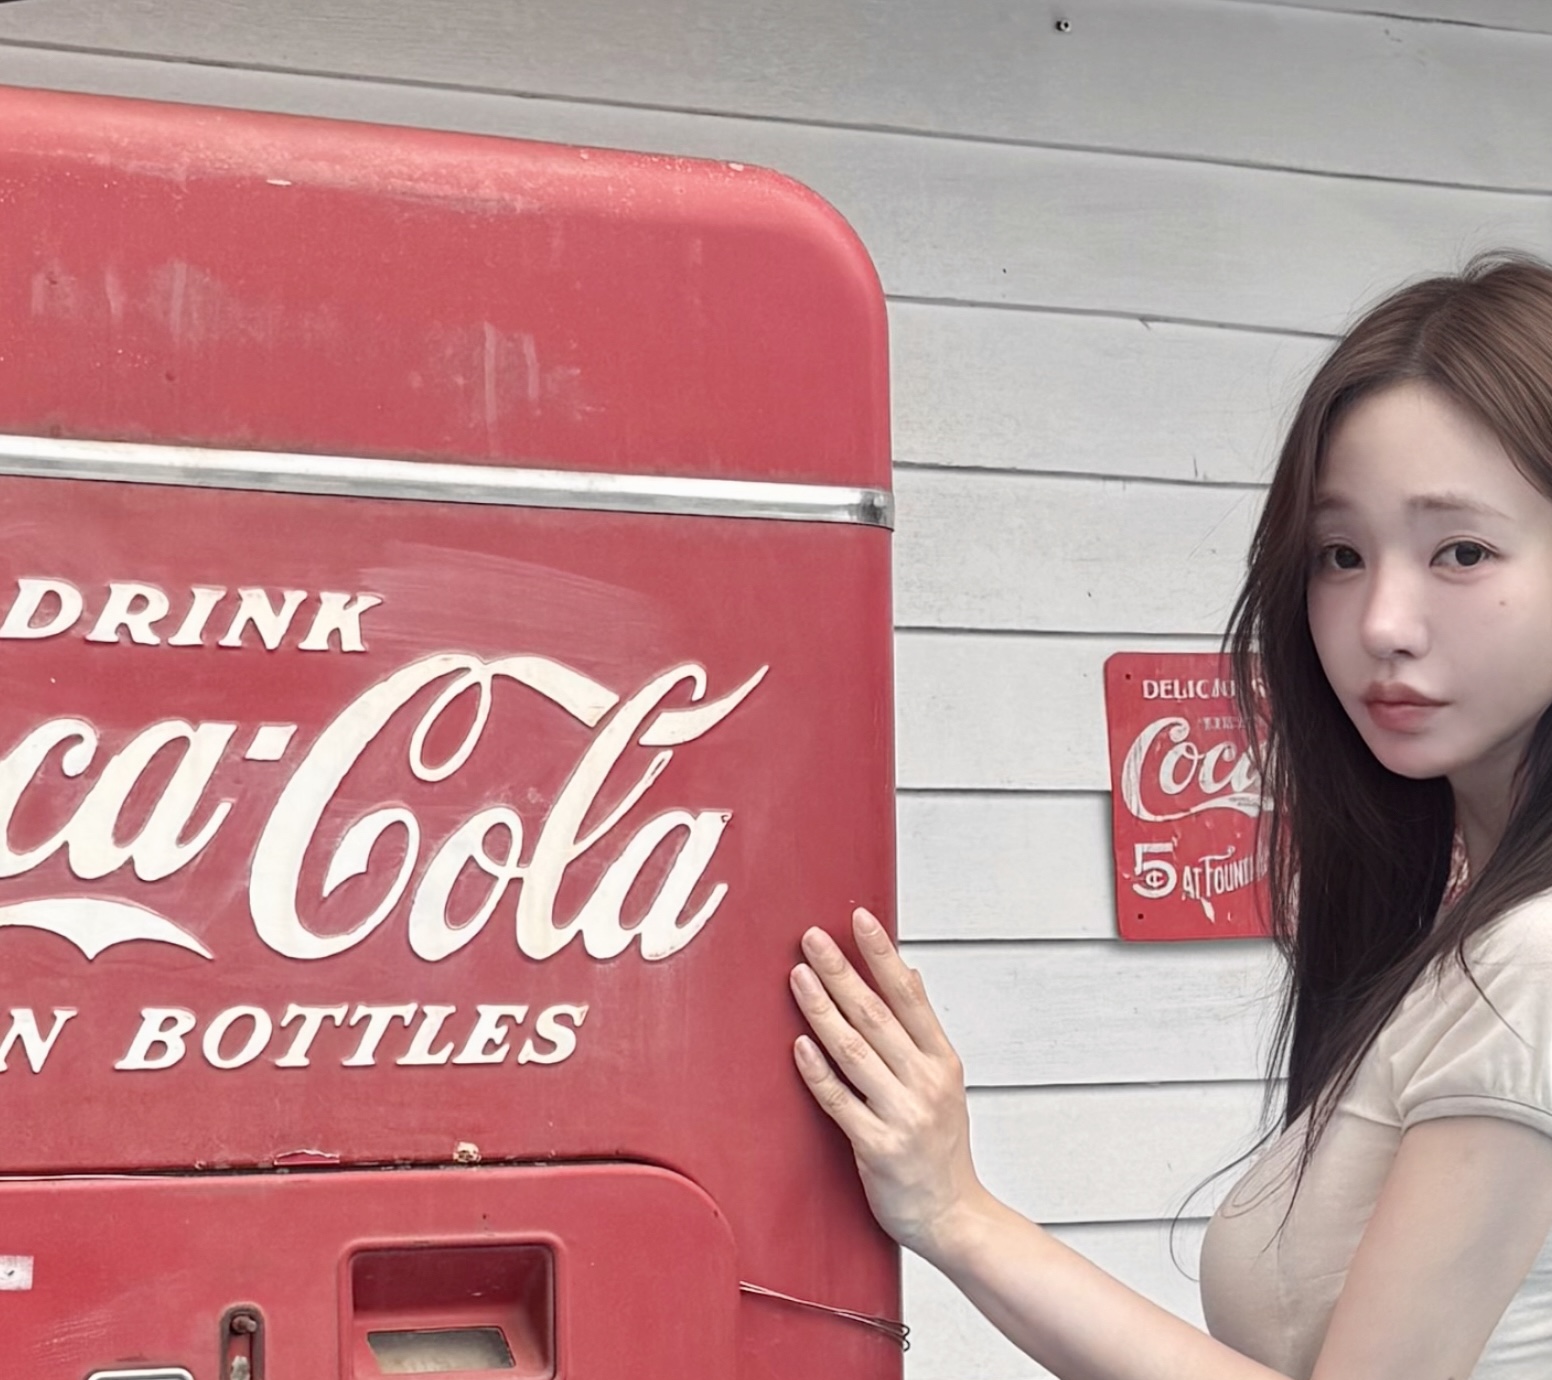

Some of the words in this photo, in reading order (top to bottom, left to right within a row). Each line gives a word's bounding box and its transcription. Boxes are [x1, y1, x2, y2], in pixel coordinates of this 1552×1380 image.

[0, 577, 384, 653] DRINK
[0, 653, 770, 961] ca-Cola
[0, 1006, 79, 1075] N
[114, 1003, 590, 1071] BOTTLES
